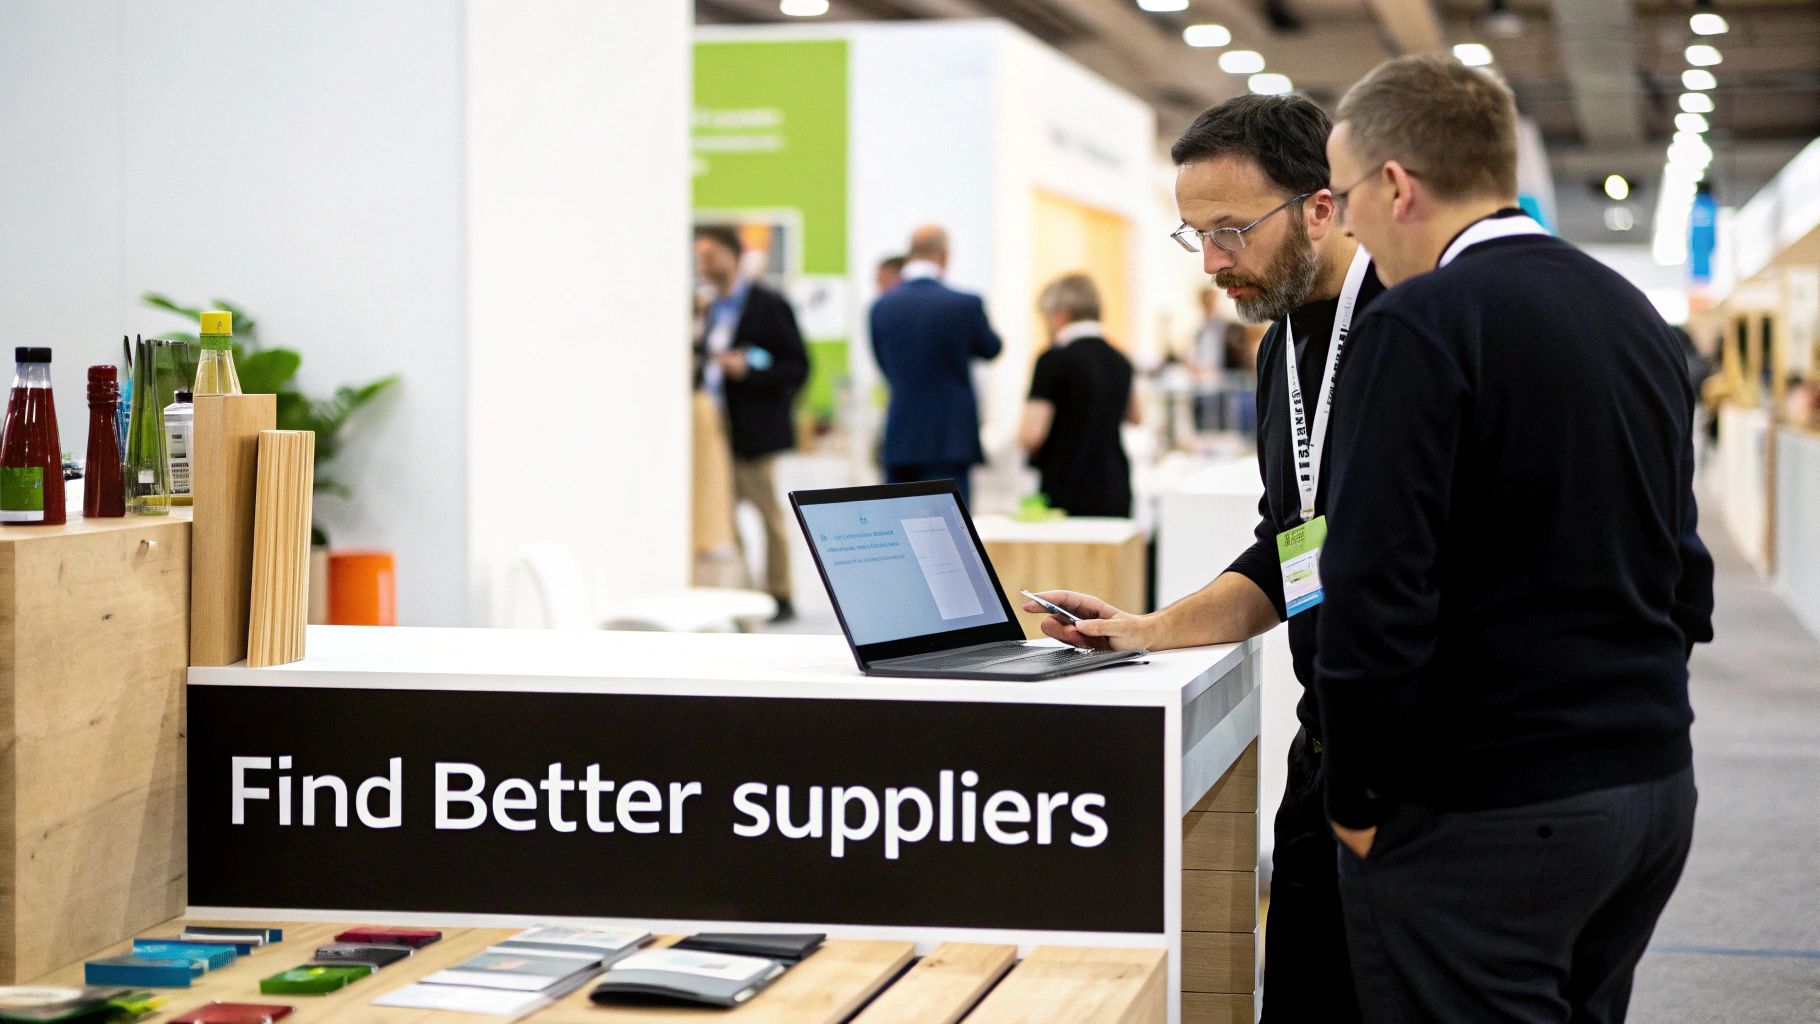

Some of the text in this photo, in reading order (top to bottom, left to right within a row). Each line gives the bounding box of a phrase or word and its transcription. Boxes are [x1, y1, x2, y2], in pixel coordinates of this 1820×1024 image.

[231, 756, 1109, 860] Find Better suppliers
